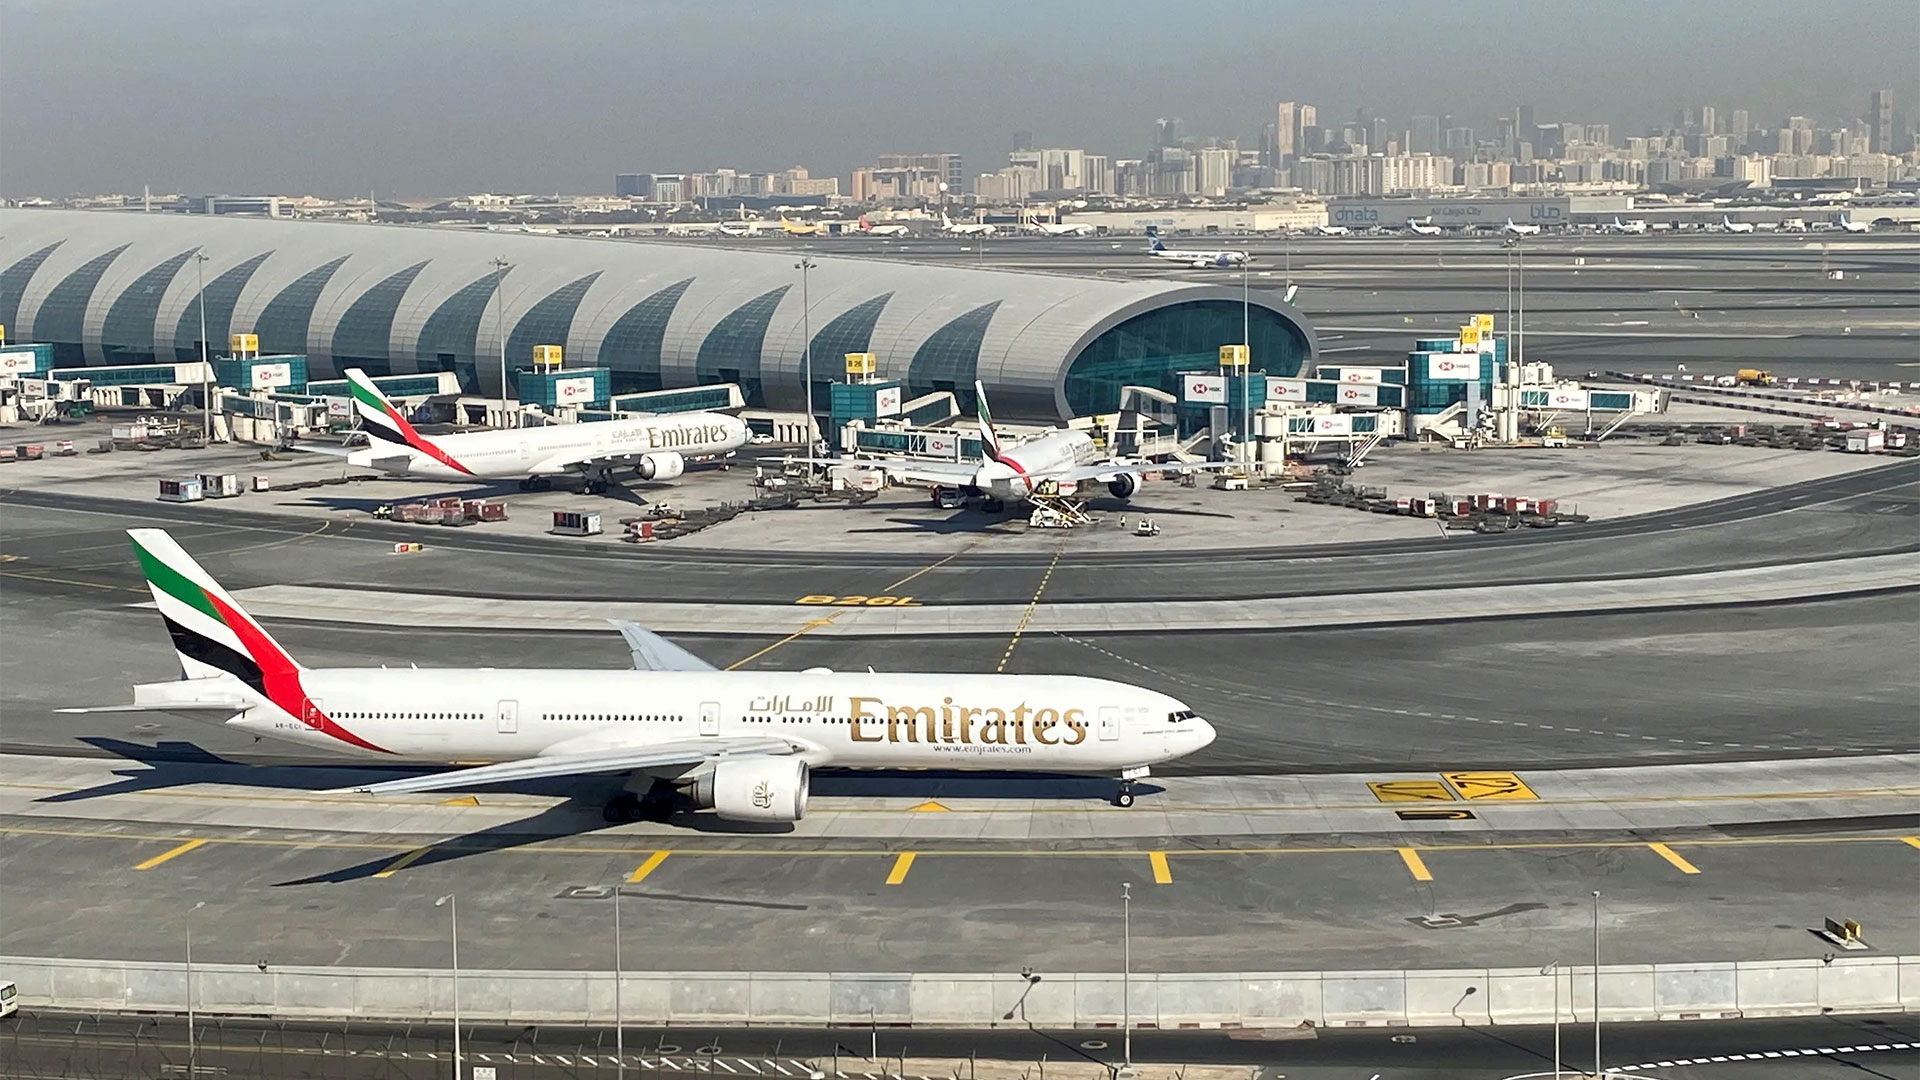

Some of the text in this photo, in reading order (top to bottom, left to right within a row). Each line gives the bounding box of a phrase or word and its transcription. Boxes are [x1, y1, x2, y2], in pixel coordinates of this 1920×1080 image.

[1335, 207, 1379, 221] dnata
[646, 424, 728, 449] Emirates
[795, 594, 924, 606] B26L
[748, 695, 834, 716] الإمارات
[849, 697, 1087, 746] Emirates
